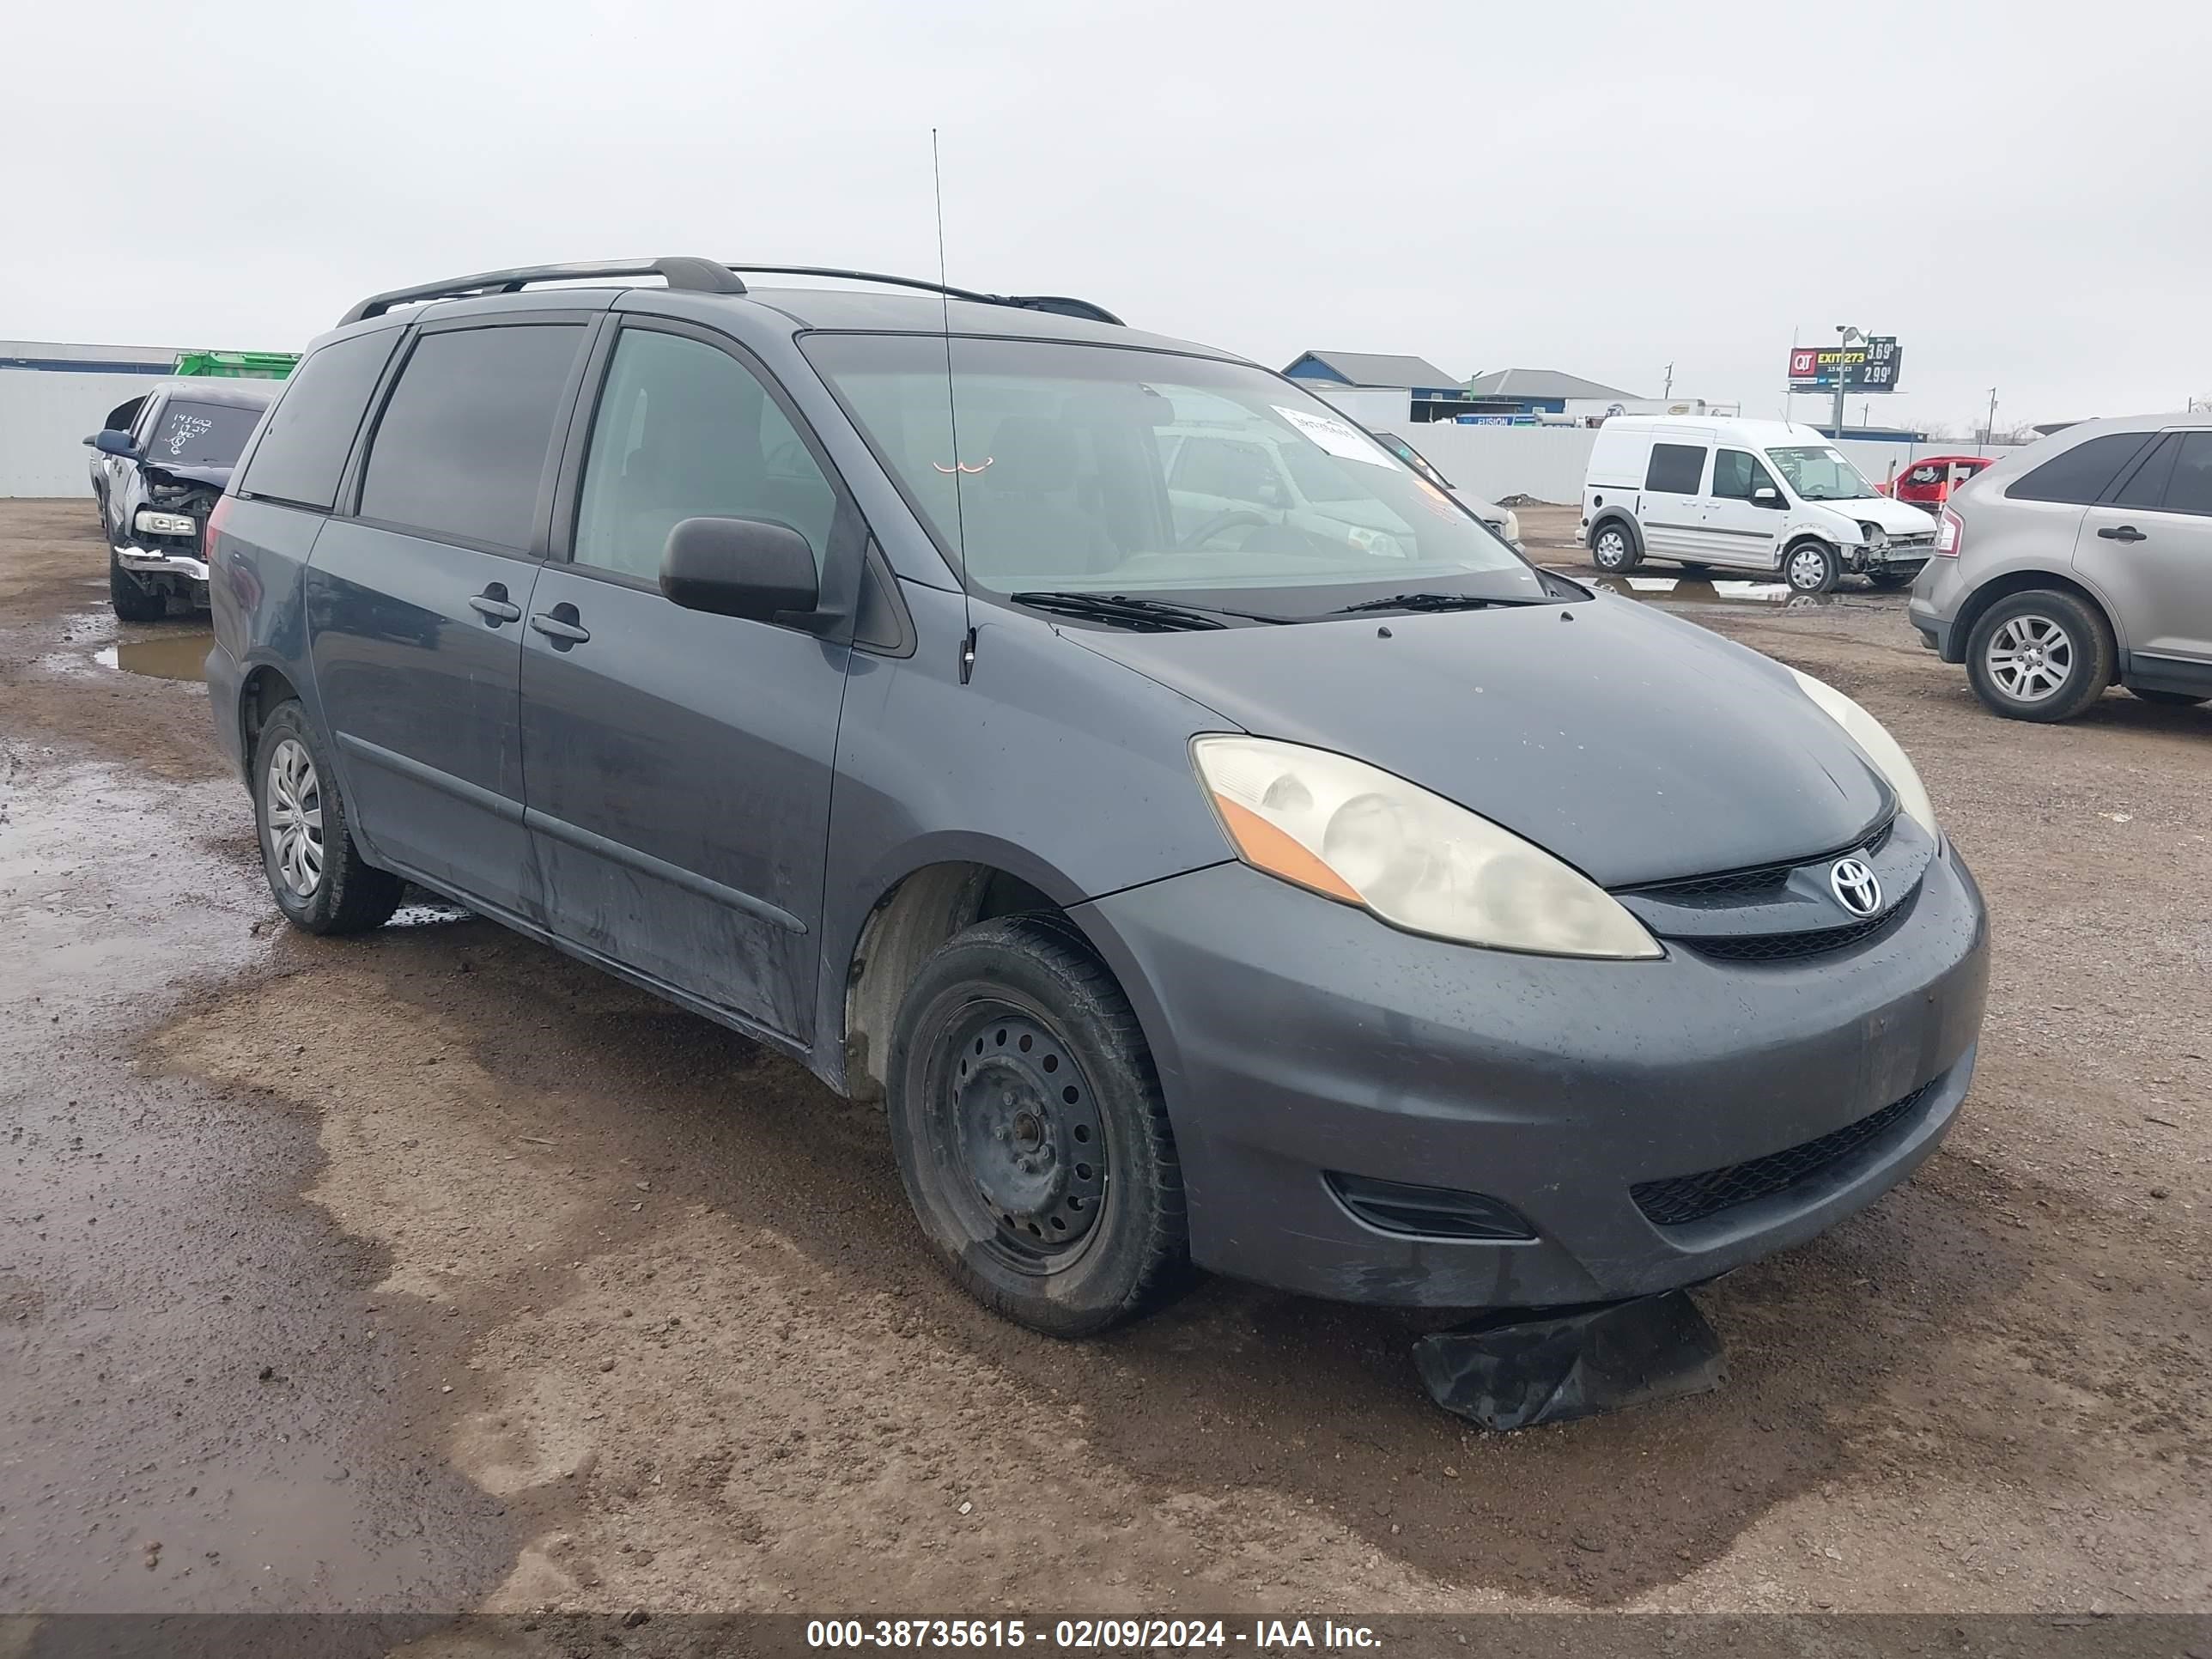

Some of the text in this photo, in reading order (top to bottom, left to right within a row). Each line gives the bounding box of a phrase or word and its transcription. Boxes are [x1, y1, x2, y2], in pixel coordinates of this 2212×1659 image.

[1794, 355, 1813, 371] QT
[1818, 353, 1864, 363] EXIT 273
[1477, 417, 1508, 426] FUSION
